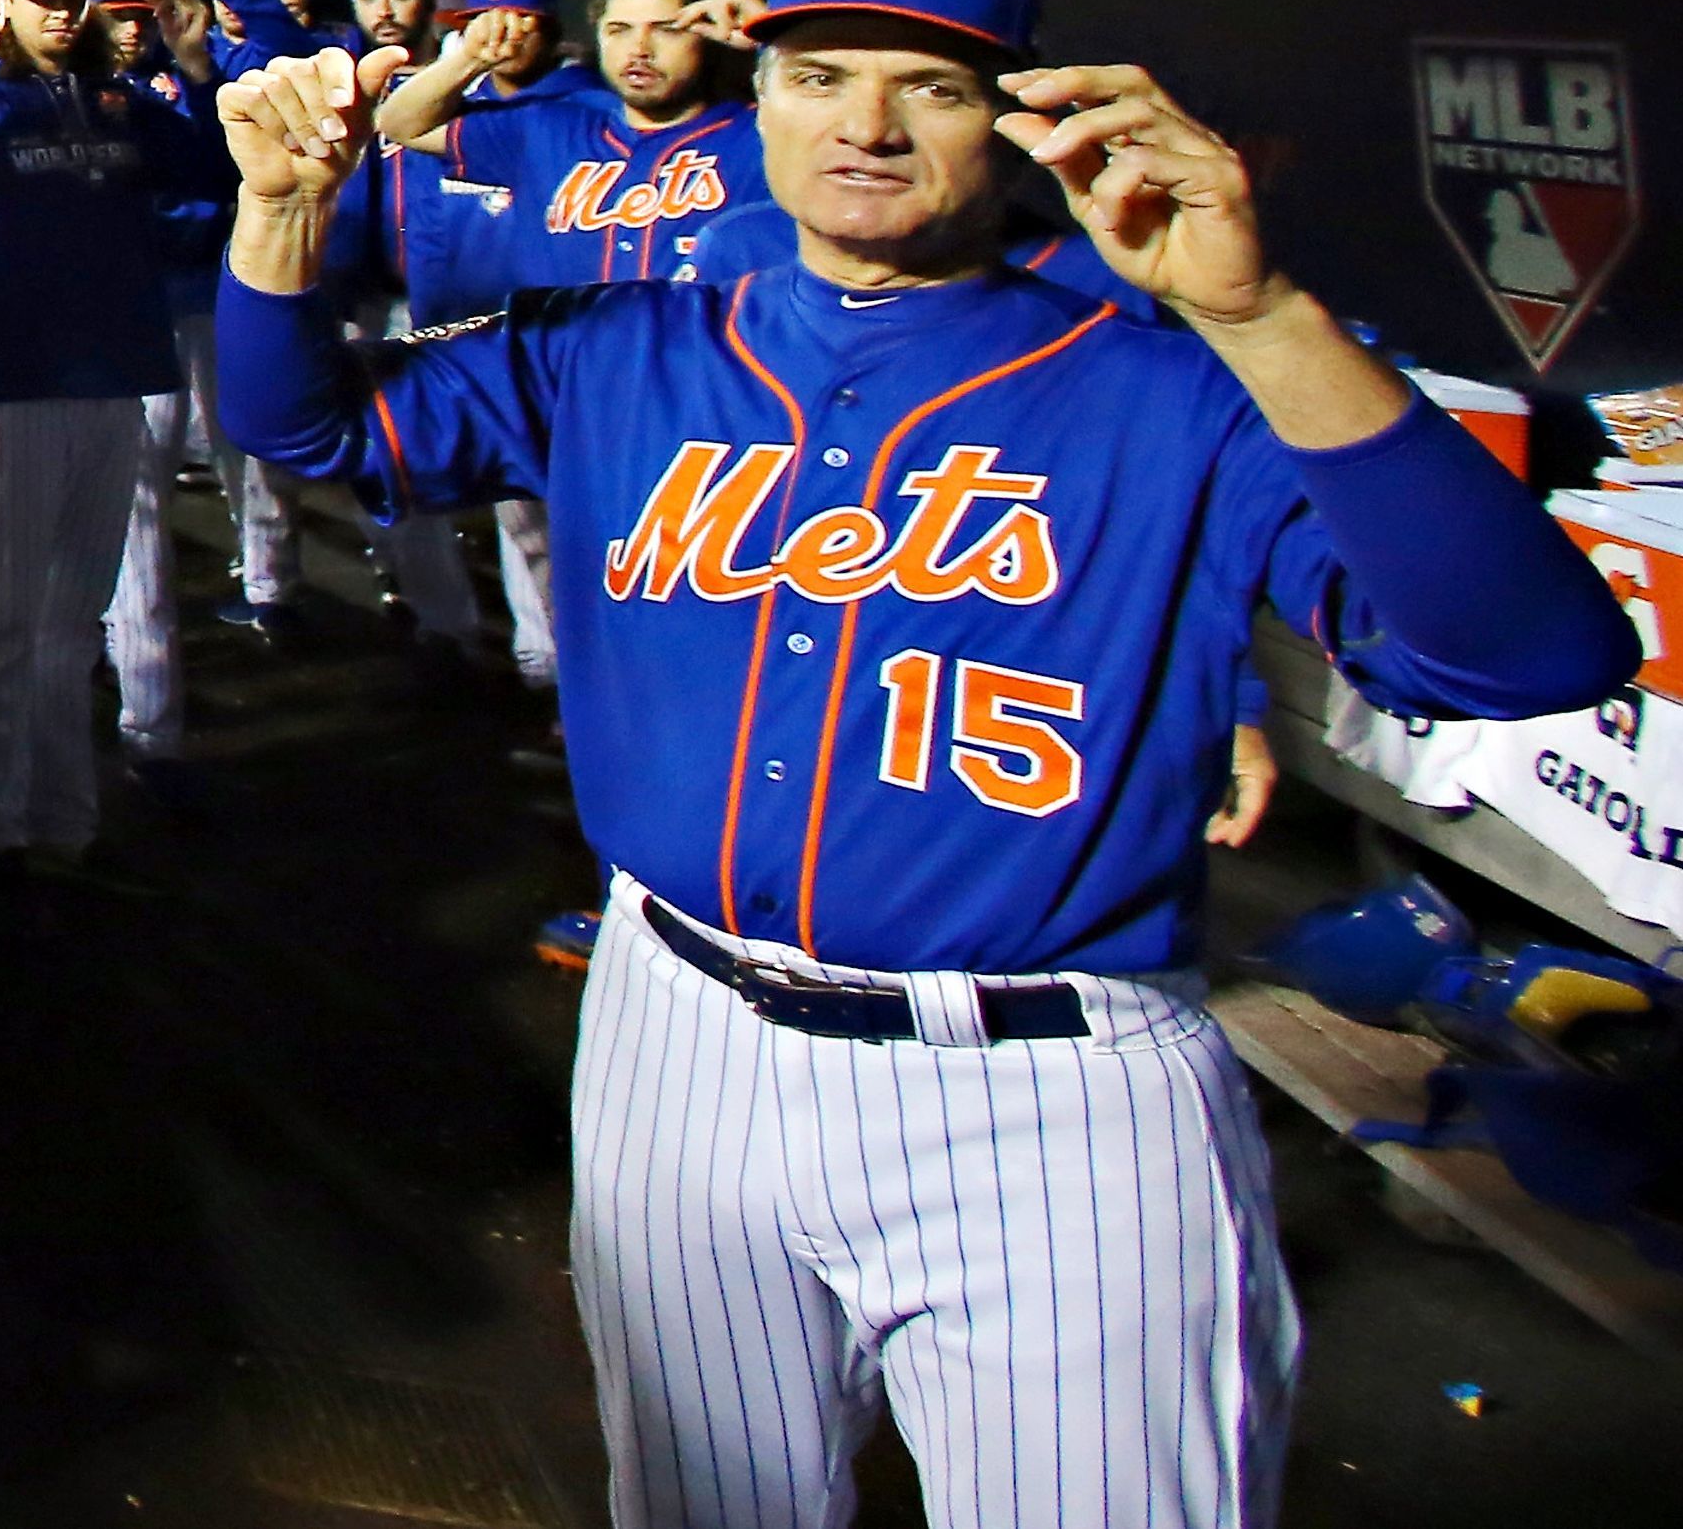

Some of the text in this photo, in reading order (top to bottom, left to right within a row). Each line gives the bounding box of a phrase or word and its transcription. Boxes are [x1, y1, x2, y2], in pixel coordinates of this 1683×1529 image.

[1426, 55, 1618, 150] MLB
[545, 149, 728, 235] Mets
[1434, 141, 1623, 185] NETWORK
[604, 440, 1059, 606] Mets
[878, 648, 1084, 818] 15
